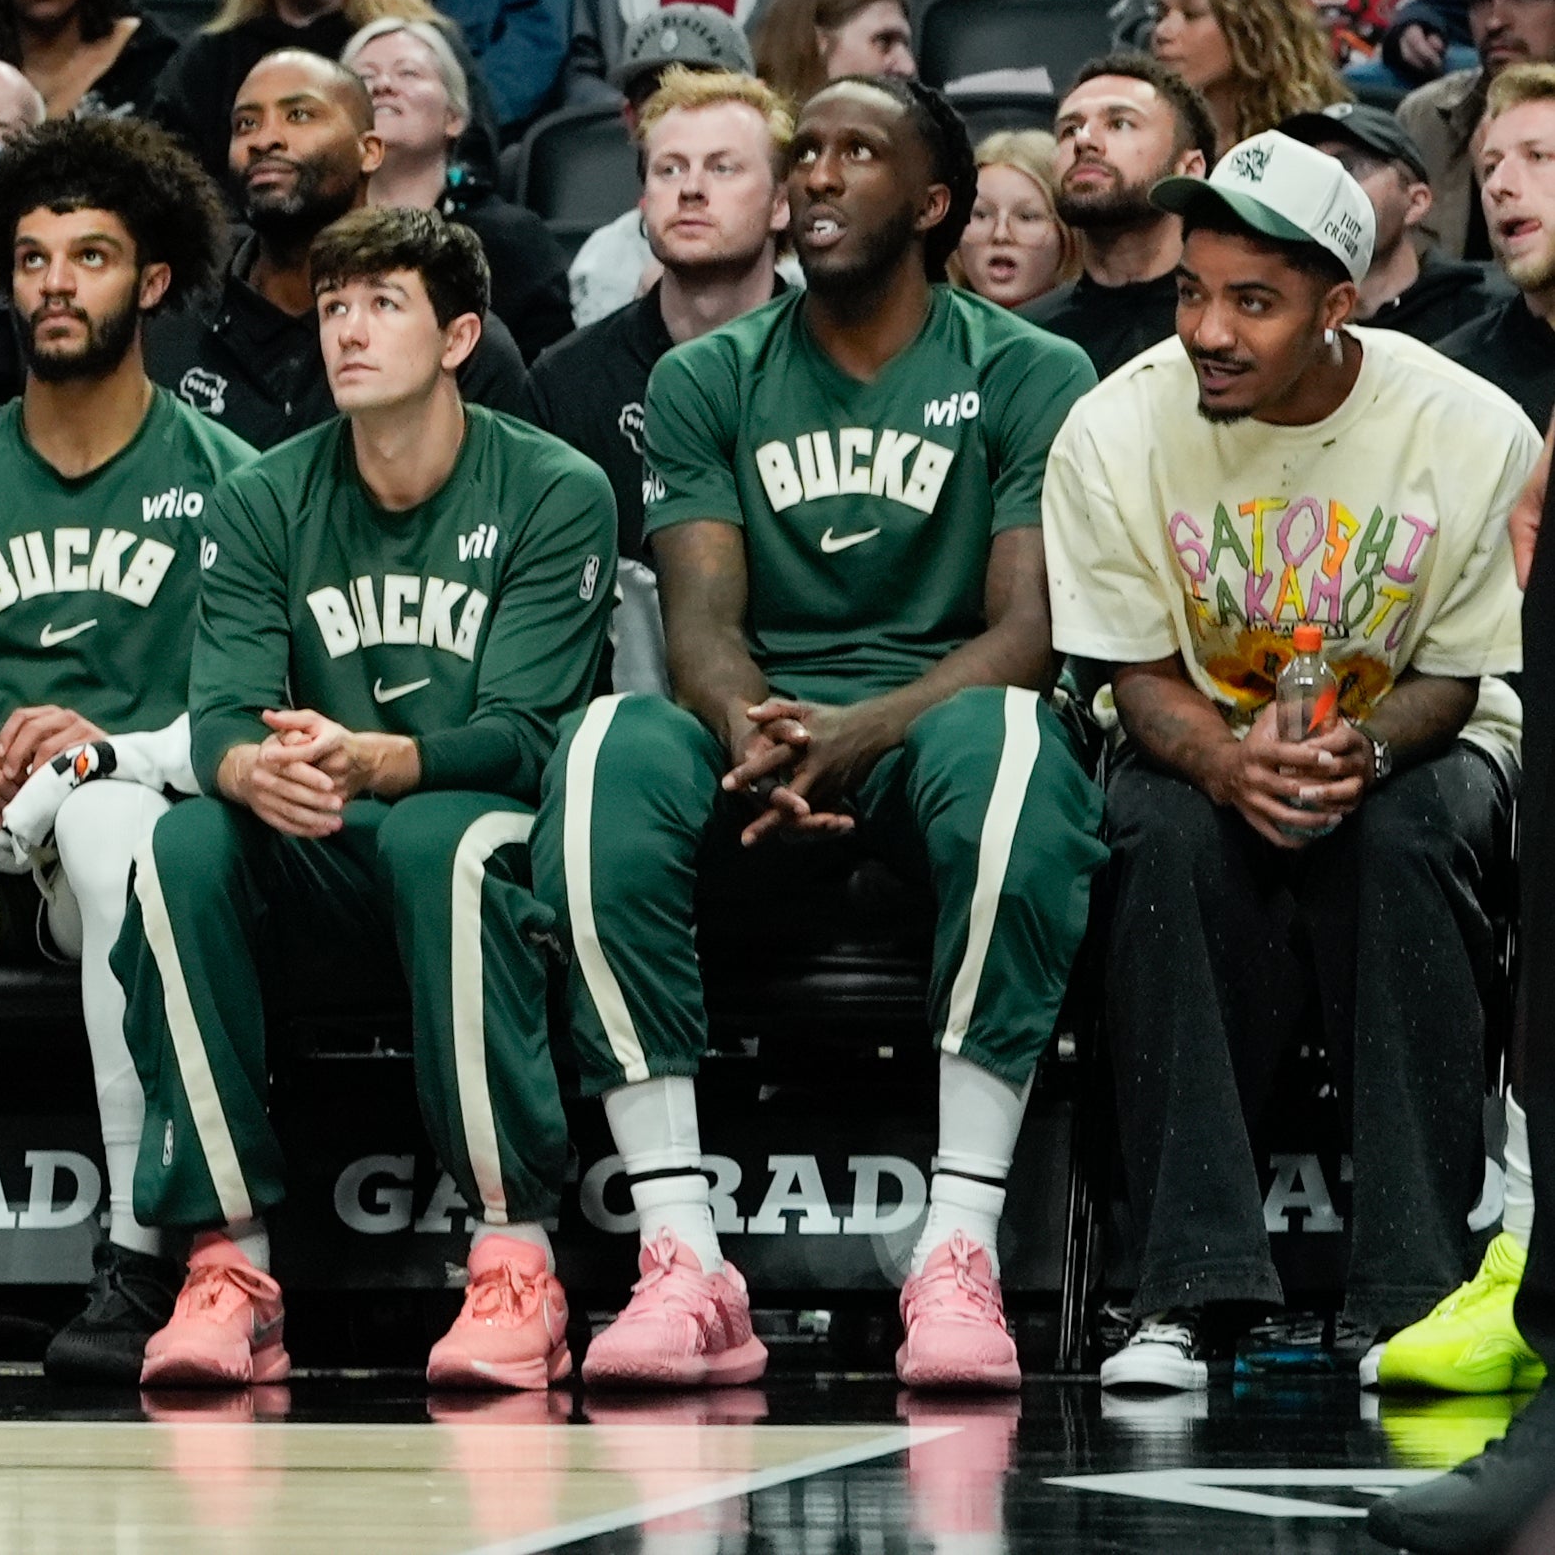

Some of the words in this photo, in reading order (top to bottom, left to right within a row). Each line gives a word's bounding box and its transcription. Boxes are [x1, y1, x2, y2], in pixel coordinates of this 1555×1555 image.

[143, 486, 204, 523] wilo
[755, 428, 955, 514] BUCKS
[458, 523, 499, 562] wil
[1169, 496, 1436, 583] SATOSHI
[307, 574, 490, 661] BUCKS
